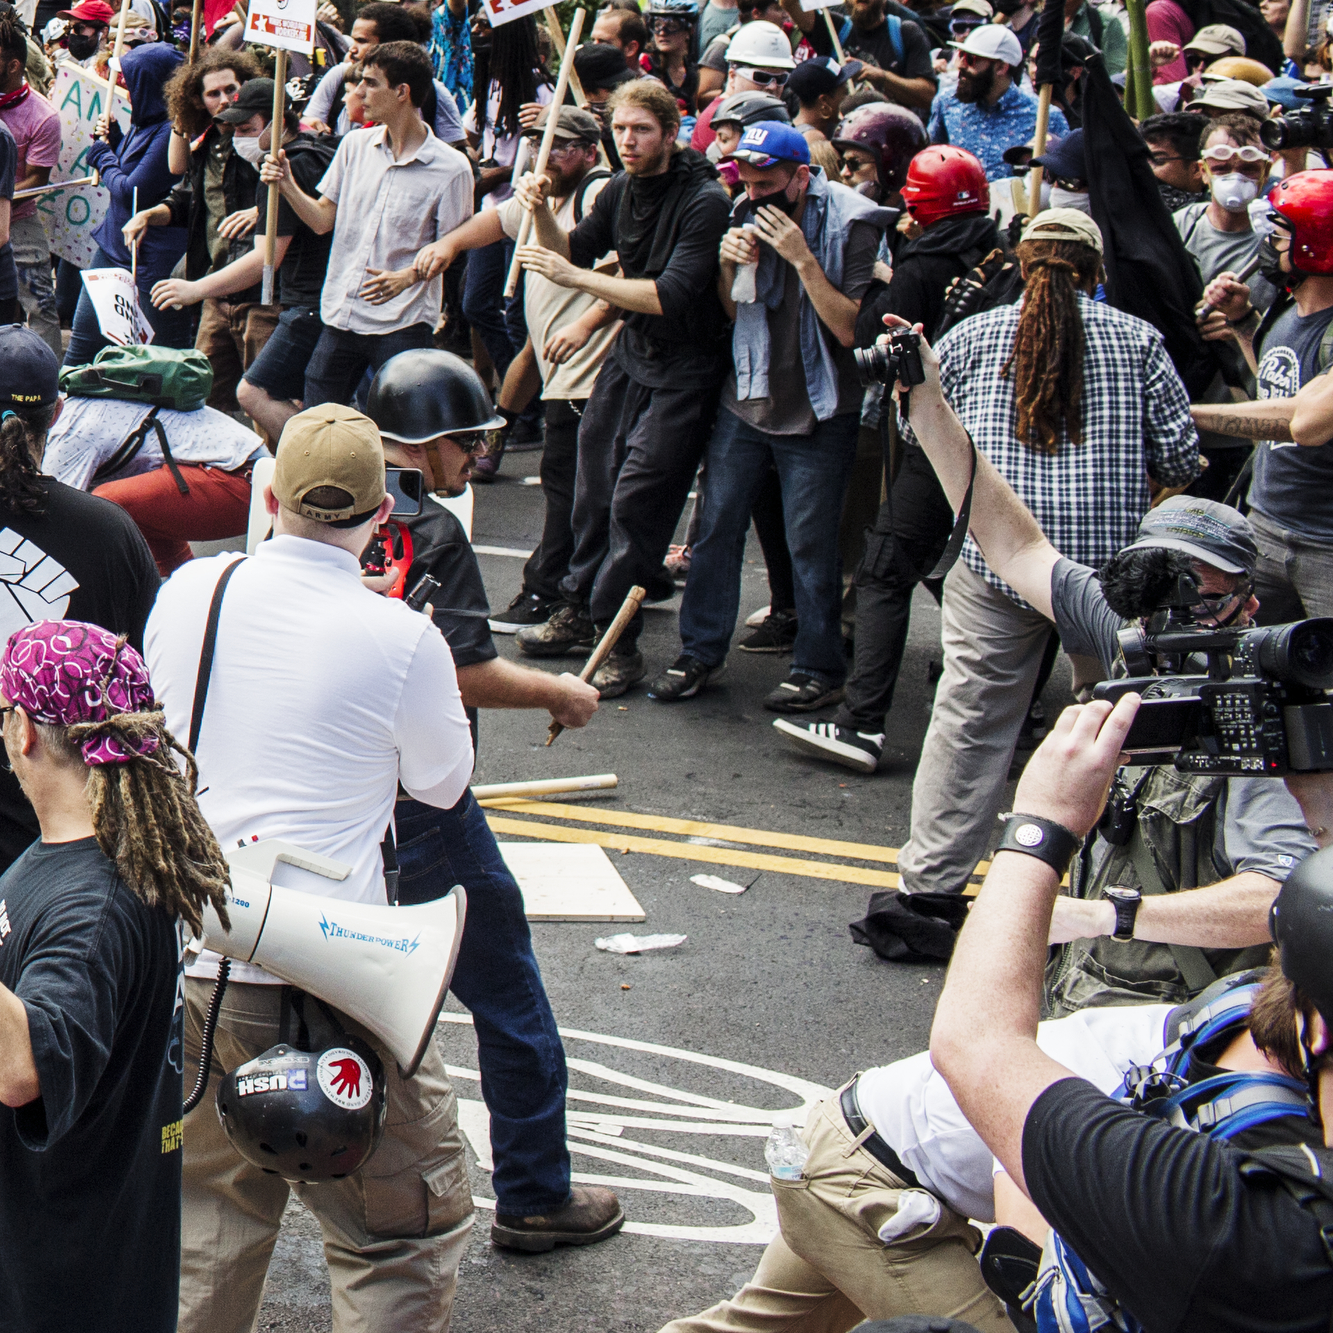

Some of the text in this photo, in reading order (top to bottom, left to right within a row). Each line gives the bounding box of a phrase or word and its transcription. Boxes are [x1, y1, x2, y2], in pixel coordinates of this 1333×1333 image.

[11, 393, 42, 403] THE PAPA
[306, 510, 340, 521] ARMY
[161, 1119, 184, 1141] BECA
